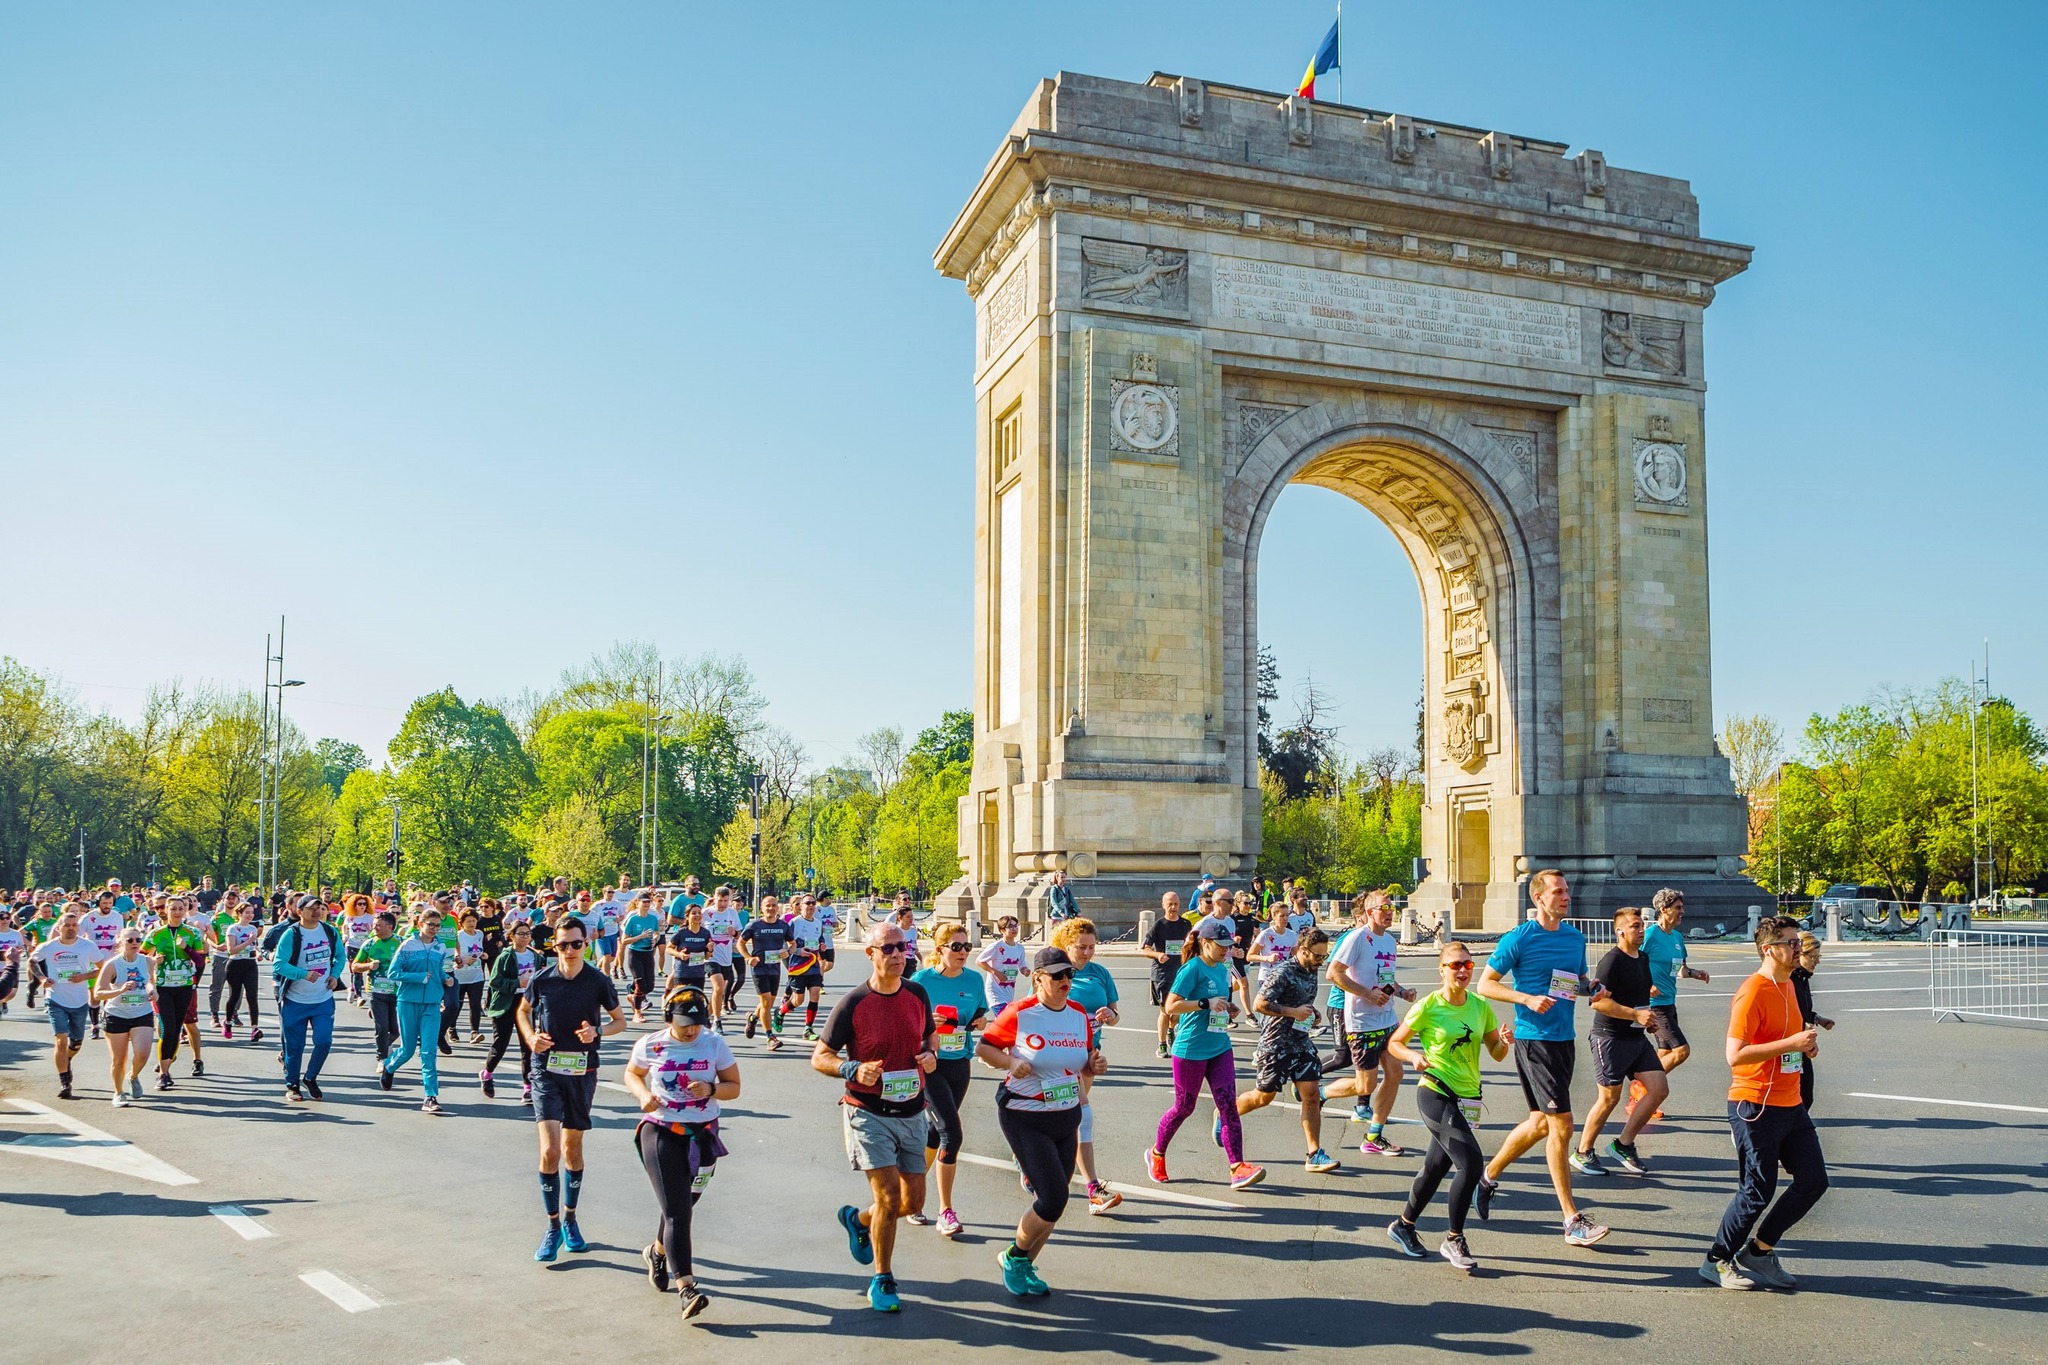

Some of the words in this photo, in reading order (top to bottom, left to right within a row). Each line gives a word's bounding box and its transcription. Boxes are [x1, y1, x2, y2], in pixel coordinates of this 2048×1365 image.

[1232, 260, 1283, 276] LIBERATOR
[1295, 269, 1306, 279] DE
[1430, 288, 1440, 298] DE
[1233, 308, 1245, 318] DE
[1491, 342, 1502, 351] LA
[1366, 313, 1379, 324] LA
[1464, 326, 1481, 338] 1922
[1048, 1039, 1087, 1048] vodafon
